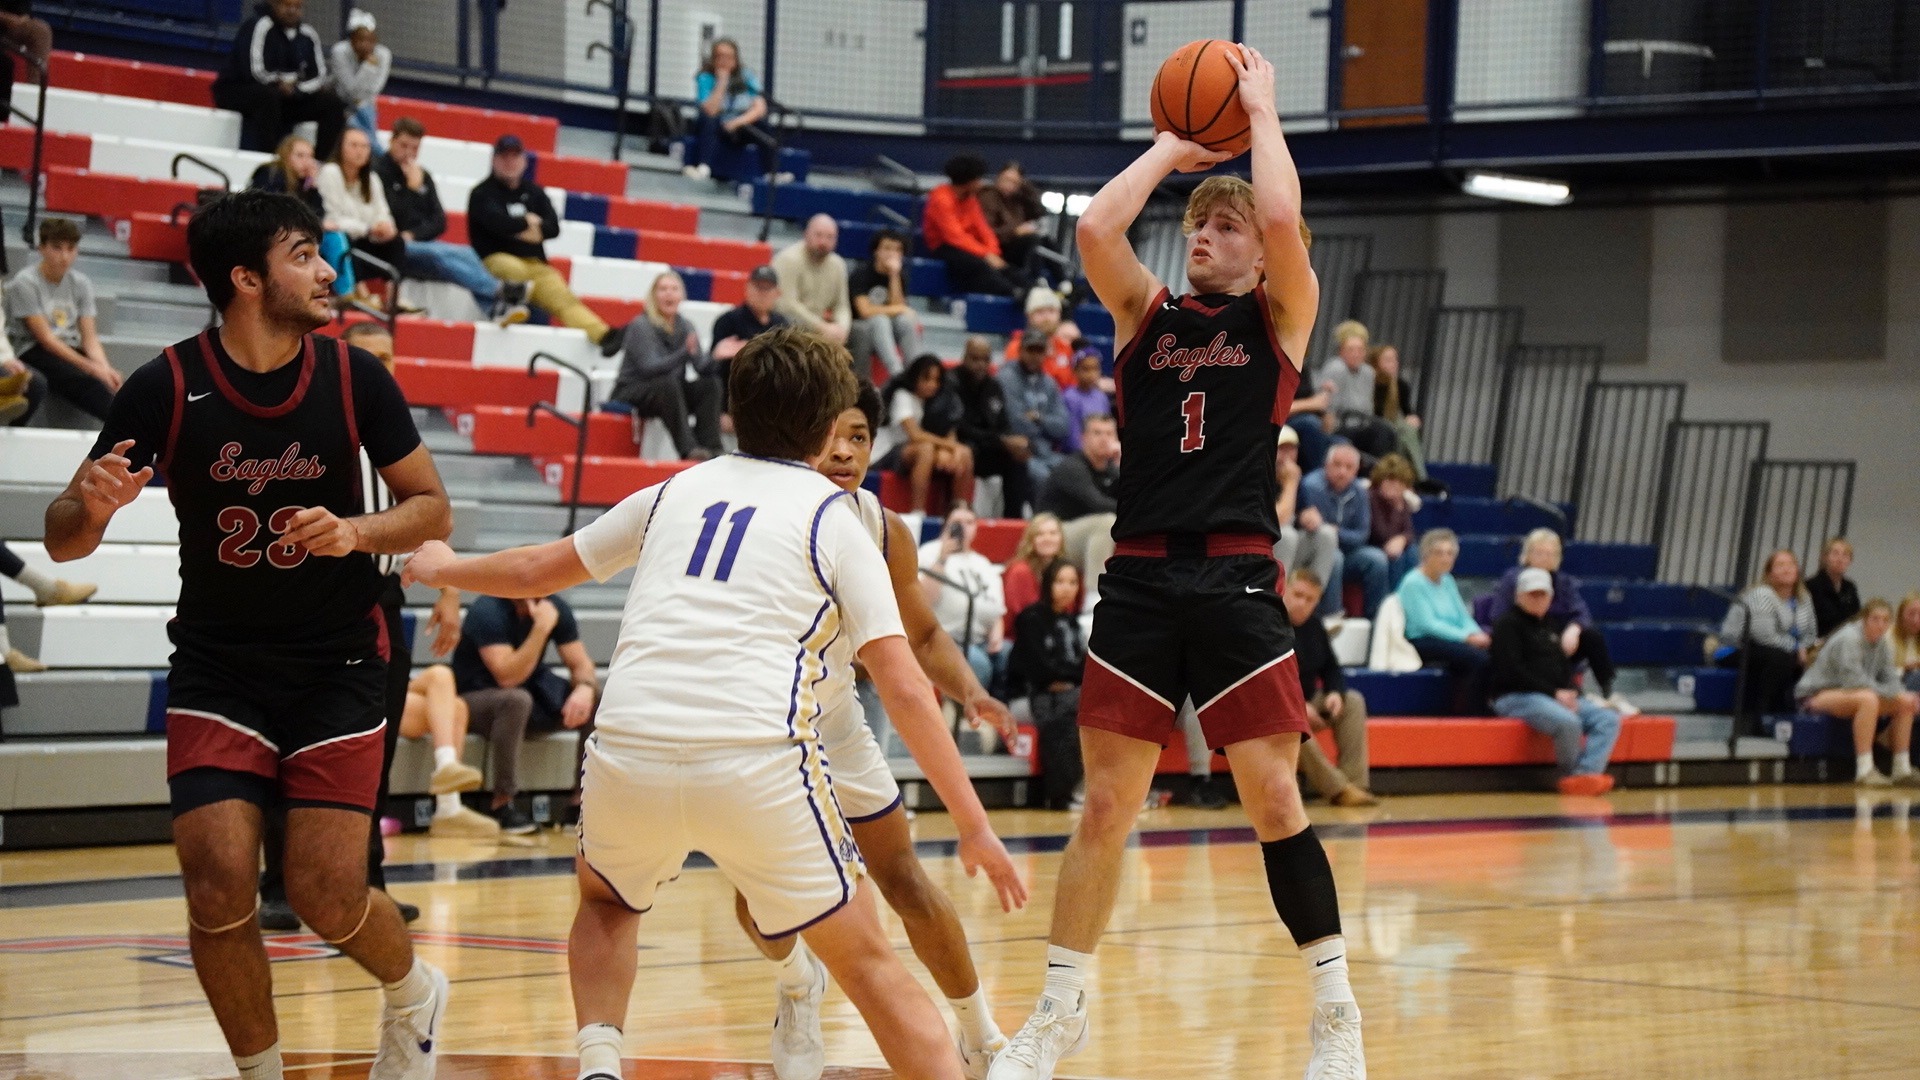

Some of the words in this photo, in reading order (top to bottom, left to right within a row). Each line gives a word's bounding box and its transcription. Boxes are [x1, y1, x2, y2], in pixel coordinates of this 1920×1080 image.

[1149, 331, 1250, 382] Eagles
[1180, 392, 1206, 453] 1
[210, 441, 326, 495] Eagles
[685, 500, 757, 582] 11
